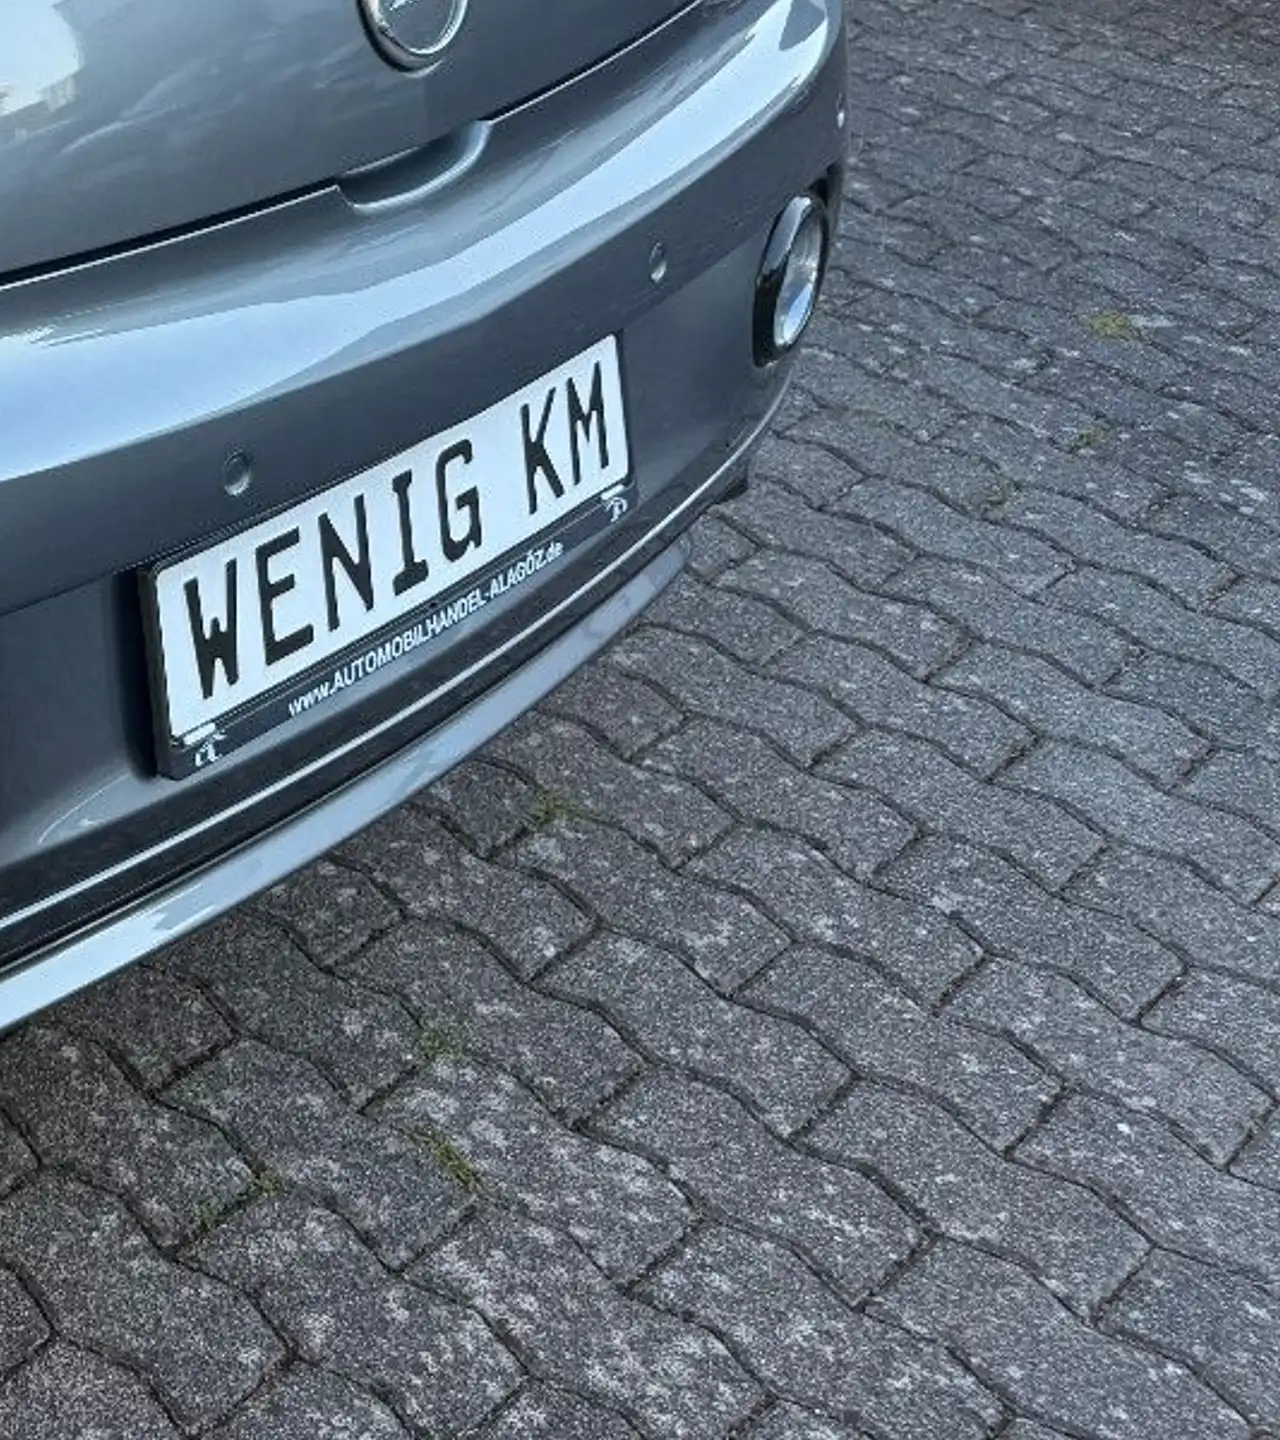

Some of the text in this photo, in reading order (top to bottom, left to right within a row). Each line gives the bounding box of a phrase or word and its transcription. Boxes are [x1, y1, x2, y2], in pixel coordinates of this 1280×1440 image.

[183, 361, 610, 700] WENIG KM
[288, 542, 565, 717] www.AUTOMOBILHANDEL-ALAGÖZ.de
